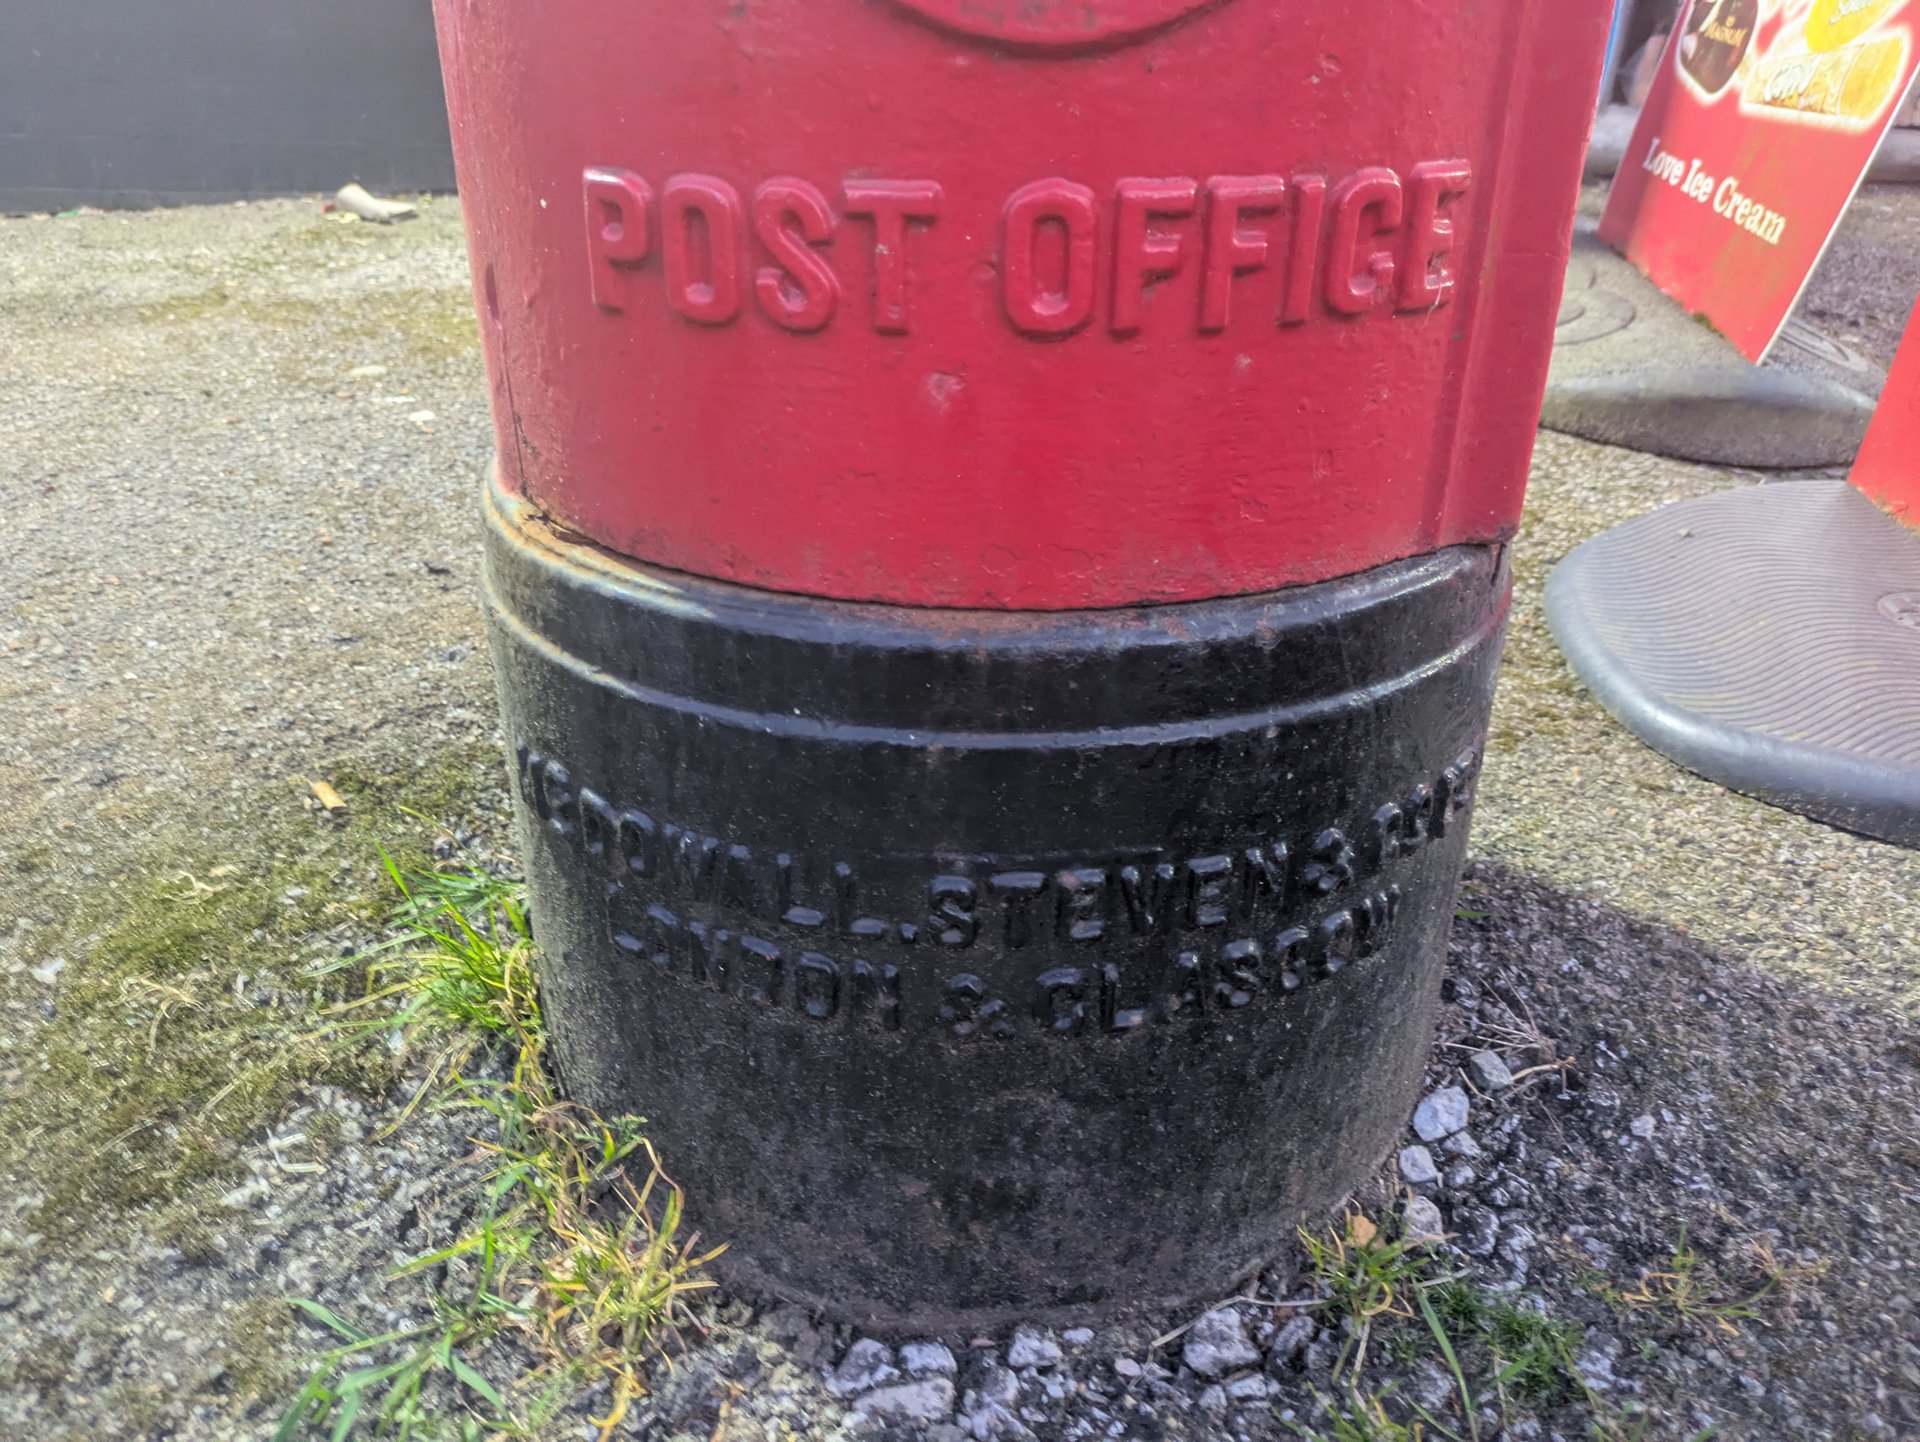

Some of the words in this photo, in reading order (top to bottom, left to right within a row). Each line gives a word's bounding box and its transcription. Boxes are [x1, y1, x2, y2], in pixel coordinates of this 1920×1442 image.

[581, 166, 942, 333] POST
[1003, 159, 1472, 337] OFFICE
[1642, 137, 1685, 186] Love
[1680, 158, 1715, 203] Ice
[1713, 176, 1786, 246] Cream
[606, 881, 900, 1031] LONDON
[937, 971, 1015, 1038] &
[1033, 883, 1400, 1031] GLASGOW
